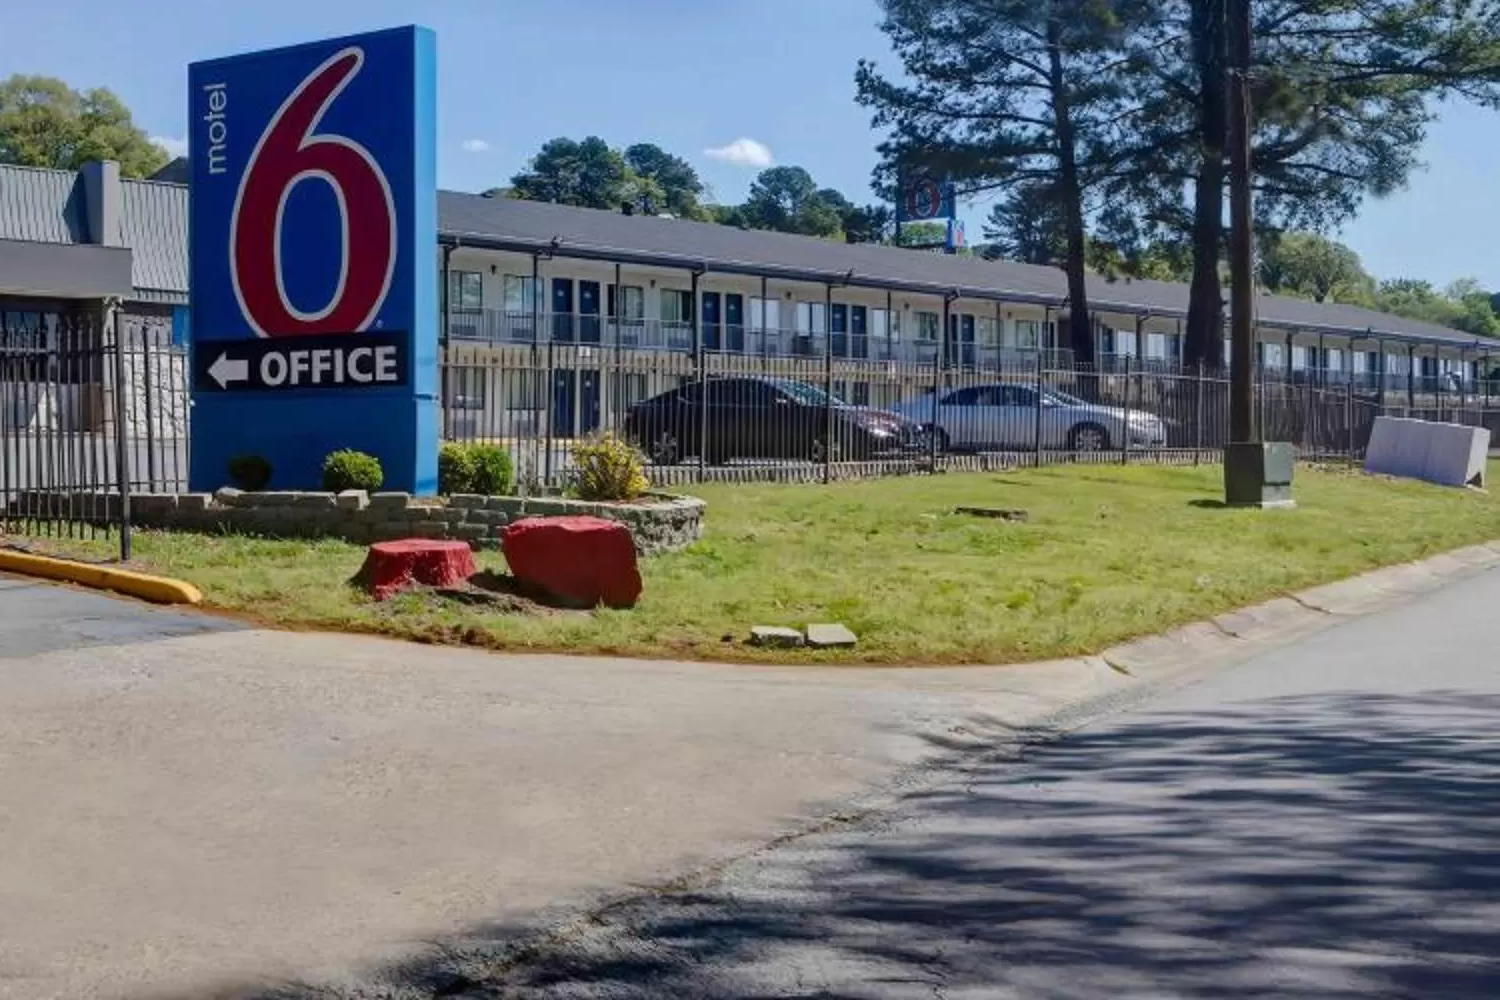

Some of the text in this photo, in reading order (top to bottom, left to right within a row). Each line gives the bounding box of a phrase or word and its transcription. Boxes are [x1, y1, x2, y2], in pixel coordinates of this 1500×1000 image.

[203, 82, 227, 175] motel
[230, 46, 397, 338] 6
[260, 345, 398, 387] OFFICE
